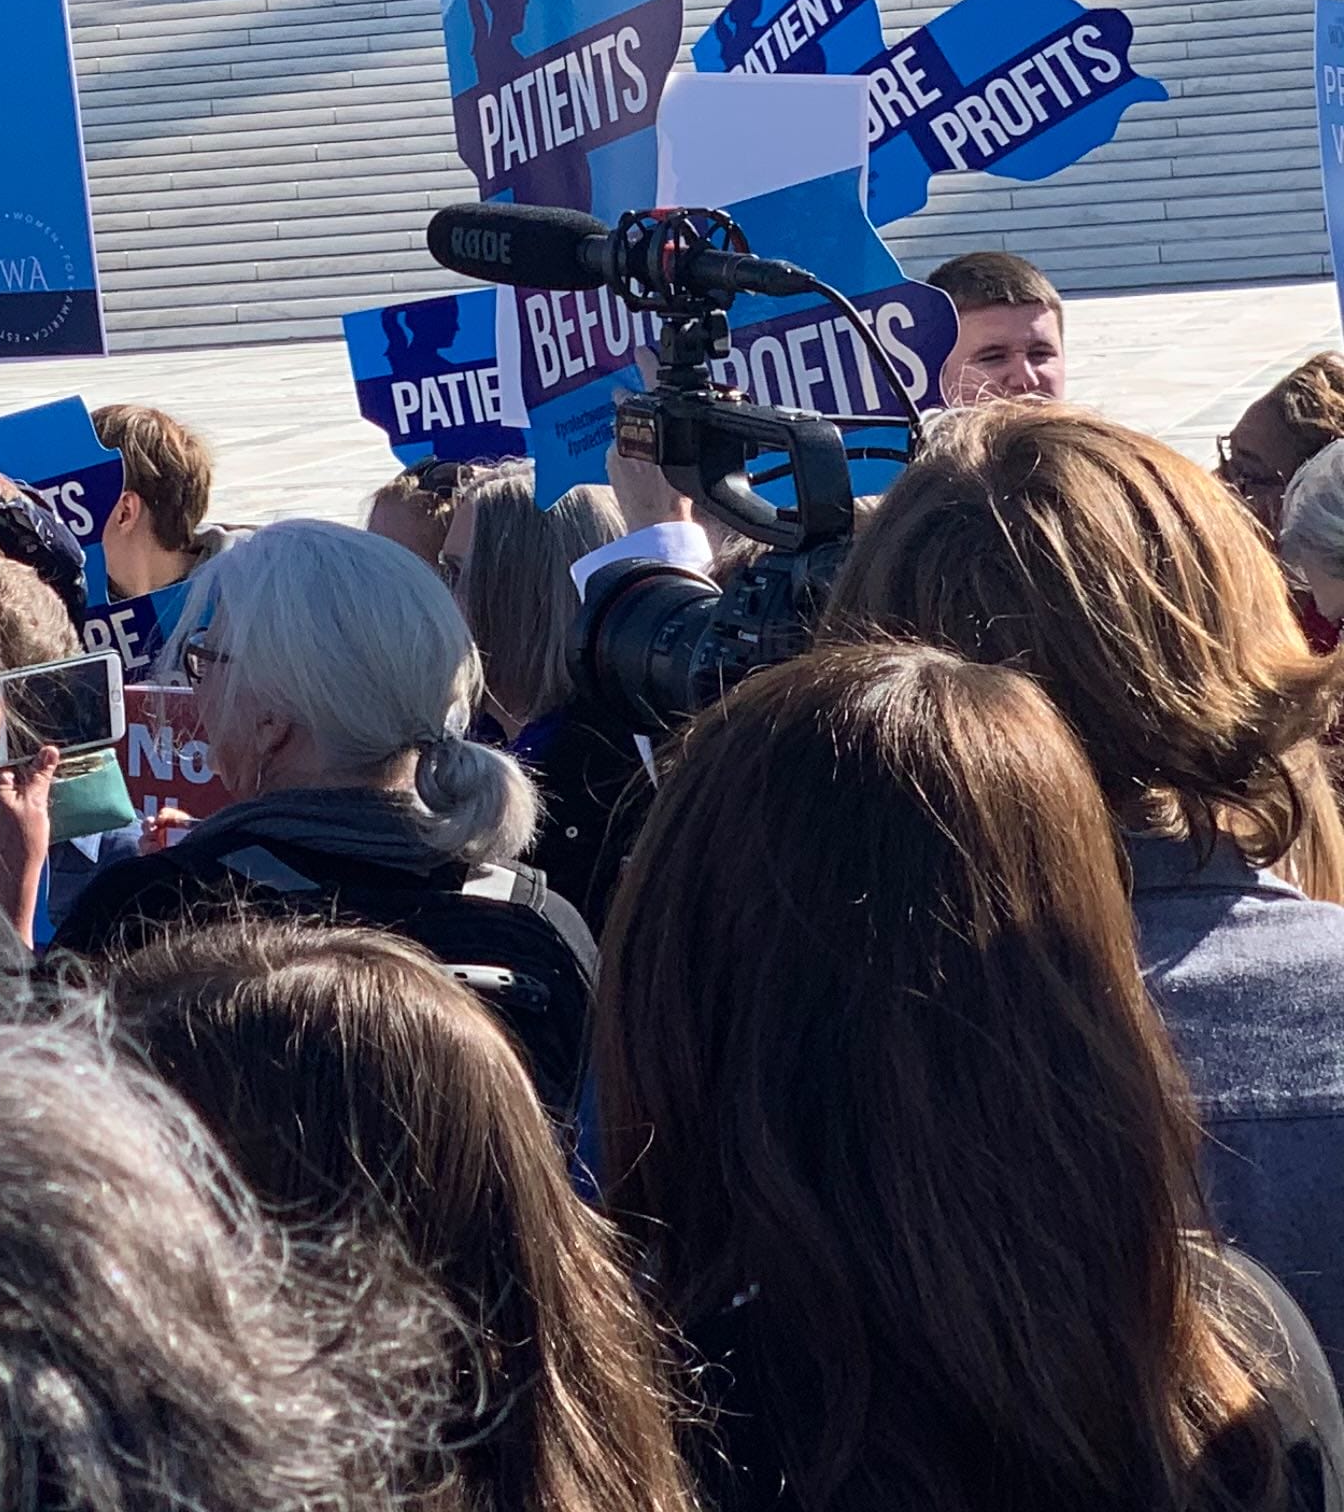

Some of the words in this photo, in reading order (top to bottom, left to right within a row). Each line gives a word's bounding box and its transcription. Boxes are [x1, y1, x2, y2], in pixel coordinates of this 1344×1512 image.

[477, 26, 648, 180] PATIENTS
[928, 24, 1122, 171] PROFITS
[391, 366, 501, 435] PATIE
[710, 301, 929, 417] ROFITS
